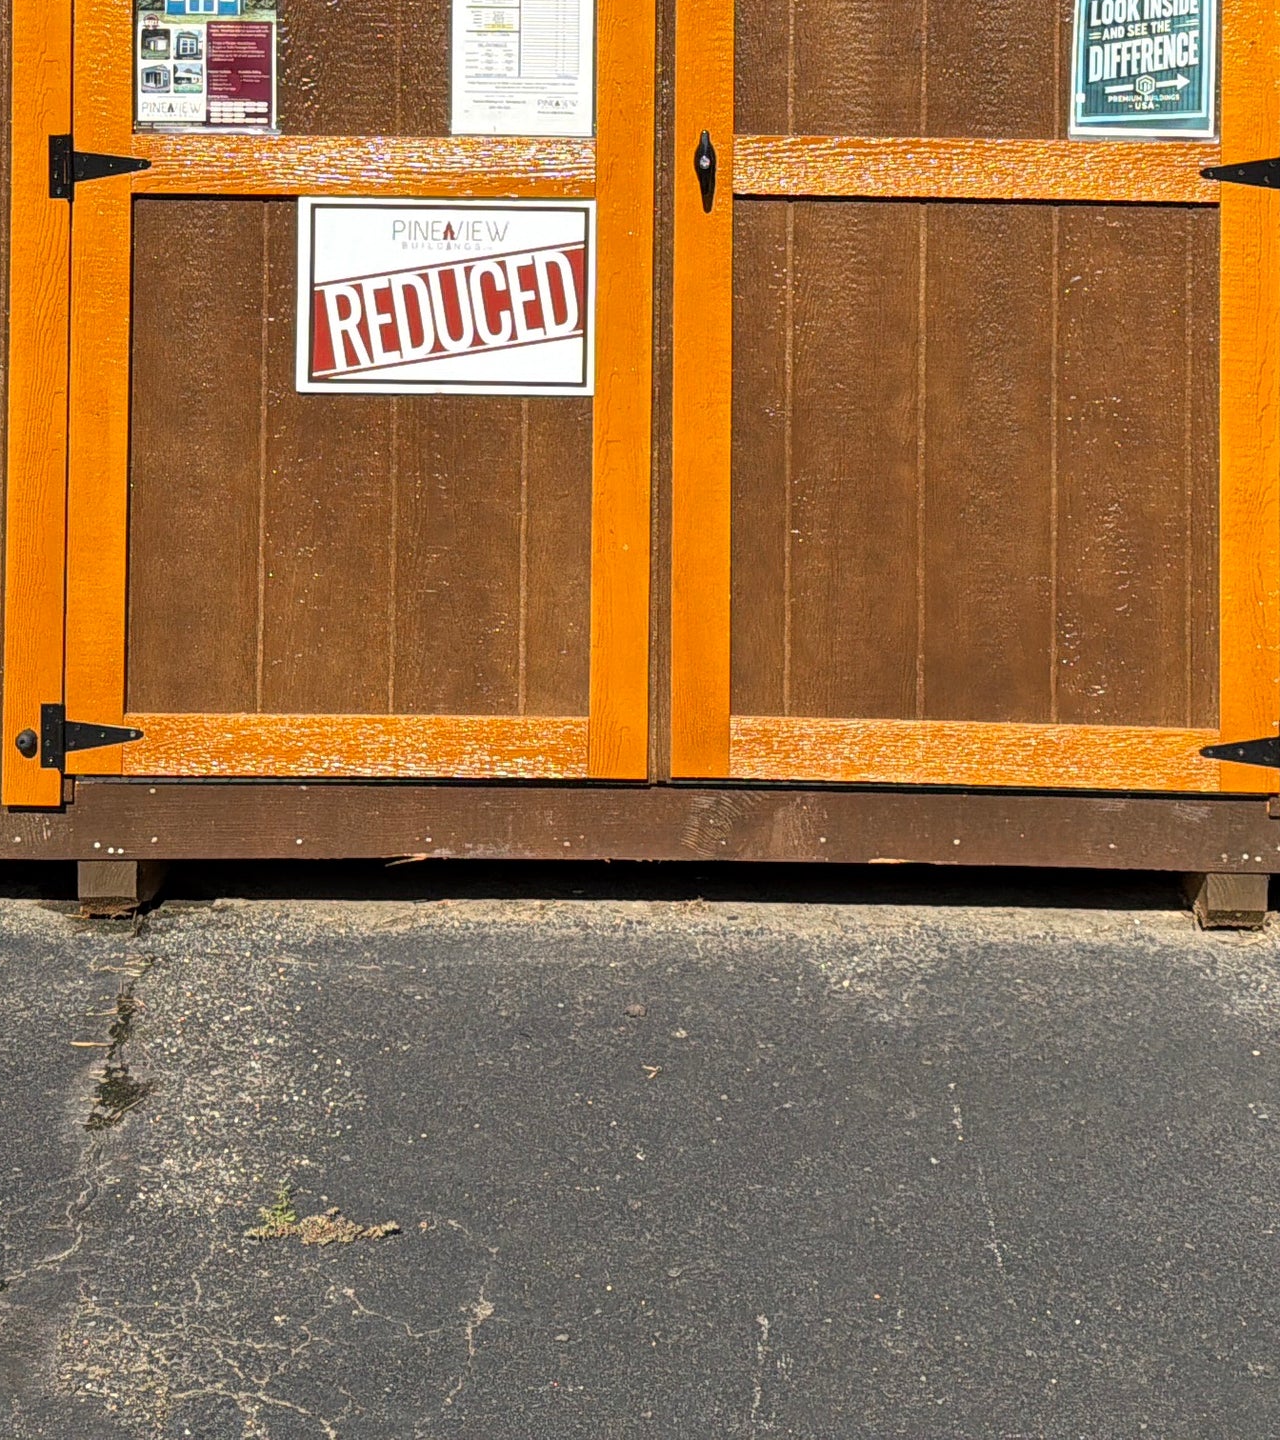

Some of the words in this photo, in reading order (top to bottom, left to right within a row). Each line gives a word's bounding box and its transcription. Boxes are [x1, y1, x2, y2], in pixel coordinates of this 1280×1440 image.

[1102, 26, 1125, 41] AND
[1127, 23, 1148, 37] SEE
[1150, 20, 1171, 33] THE
[1088, 30, 1199, 83] DIFFERENCE
[1108, 95, 1142, 103] PREMIUM
[323, 251, 579, 370] REDUCED
